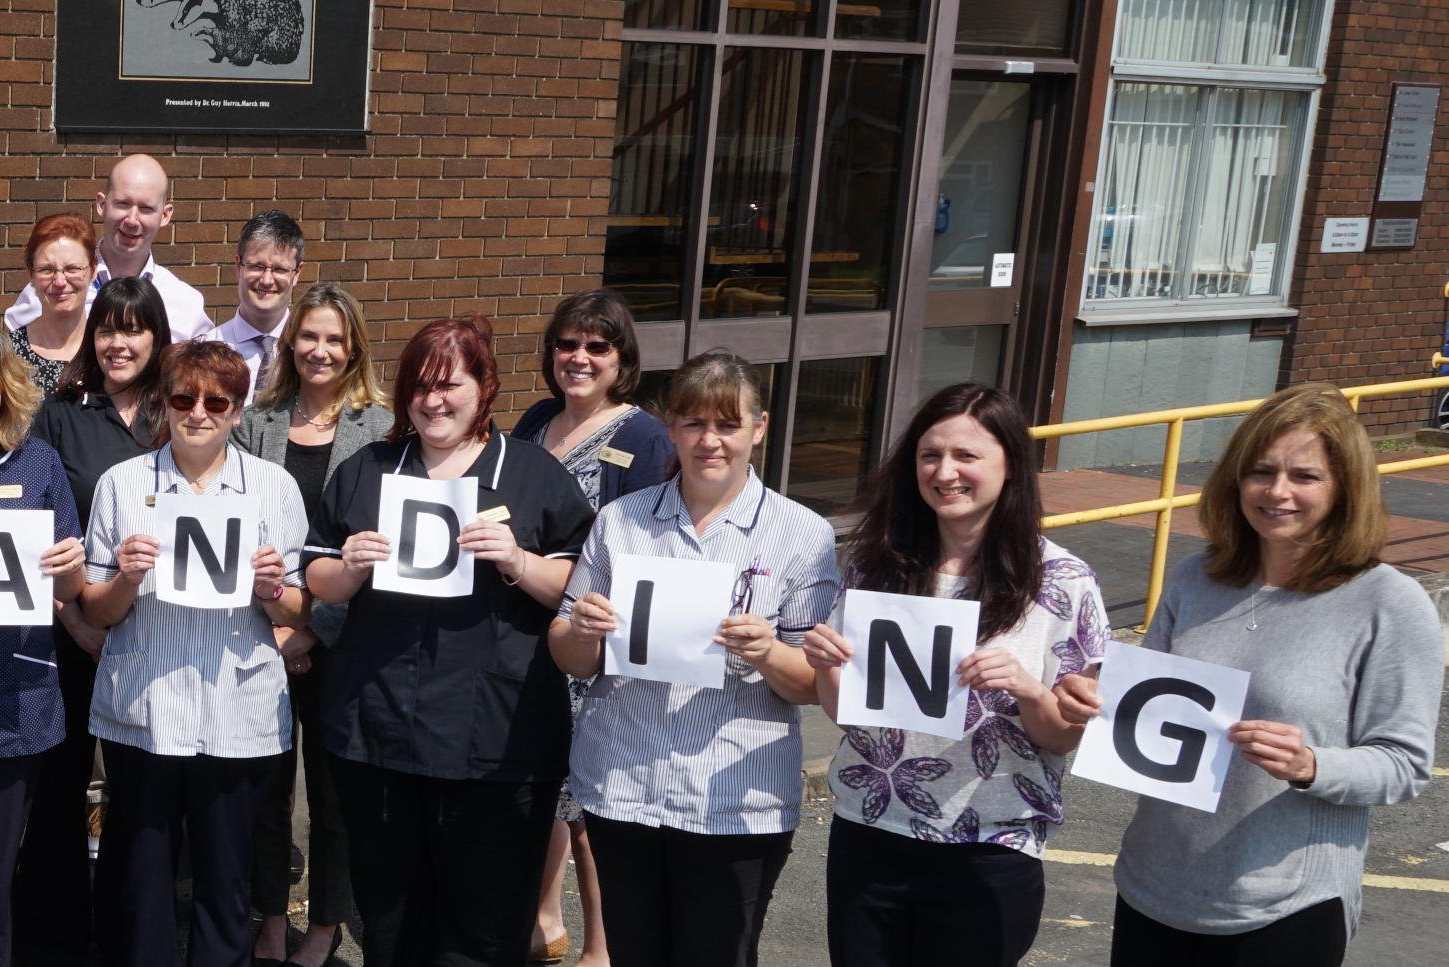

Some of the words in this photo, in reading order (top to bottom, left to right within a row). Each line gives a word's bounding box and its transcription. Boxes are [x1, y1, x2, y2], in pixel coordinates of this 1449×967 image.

[165, 98, 193, 106] Presented
[194, 99, 201, 108] by
[210, 99, 221, 108] Guy
[173, 516, 241, 594] N
[397, 498, 460, 581] D
[628, 580, 654, 666] I
[865, 618, 953, 719] N
[1112, 677, 1216, 783] G
